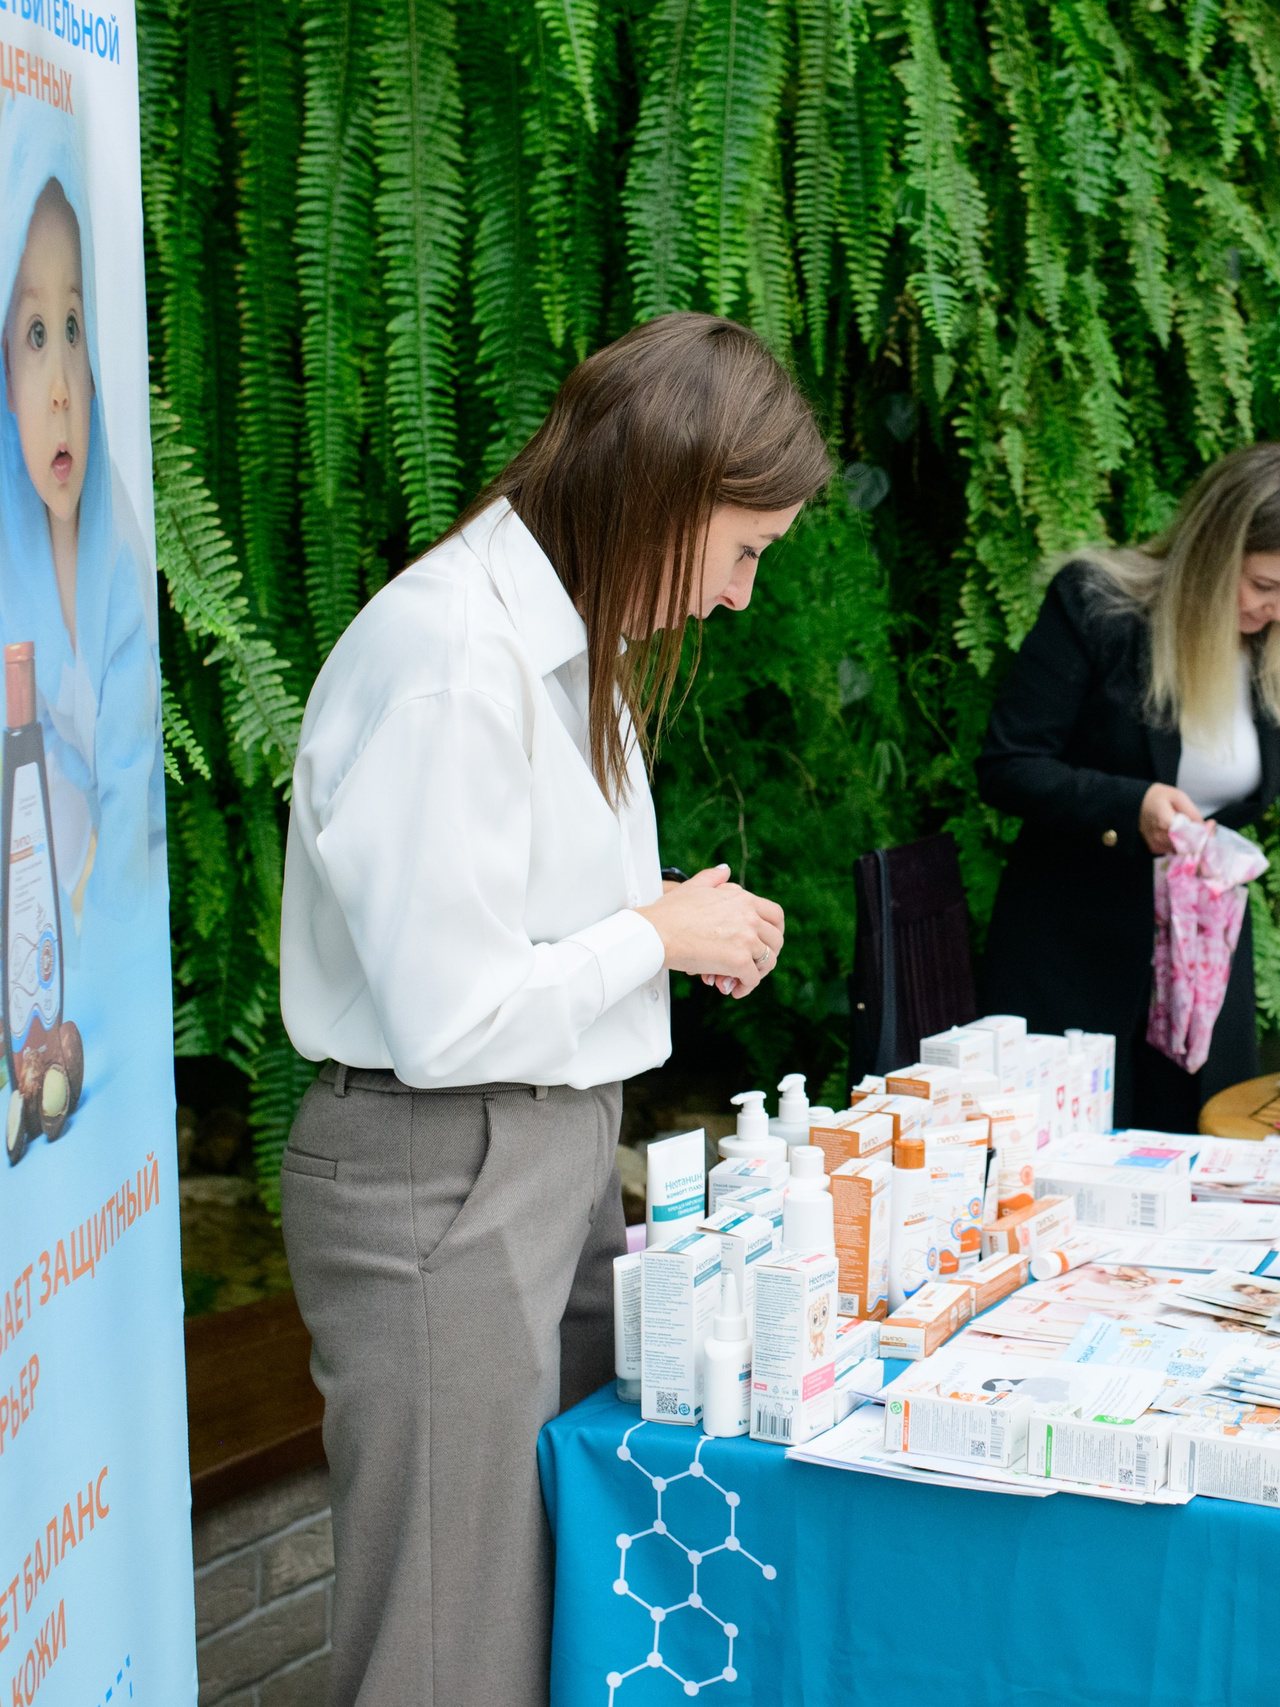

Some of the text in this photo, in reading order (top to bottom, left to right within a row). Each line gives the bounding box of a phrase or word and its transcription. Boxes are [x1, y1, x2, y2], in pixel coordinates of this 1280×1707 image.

[38, 1151, 160, 1307] ЗАЩИТНЫЙ
[665, 1173, 703, 1191] Неотанин
[23, 1465, 109, 1614] БАЛАНС
[12, 1598, 66, 1707] КОЖИ
